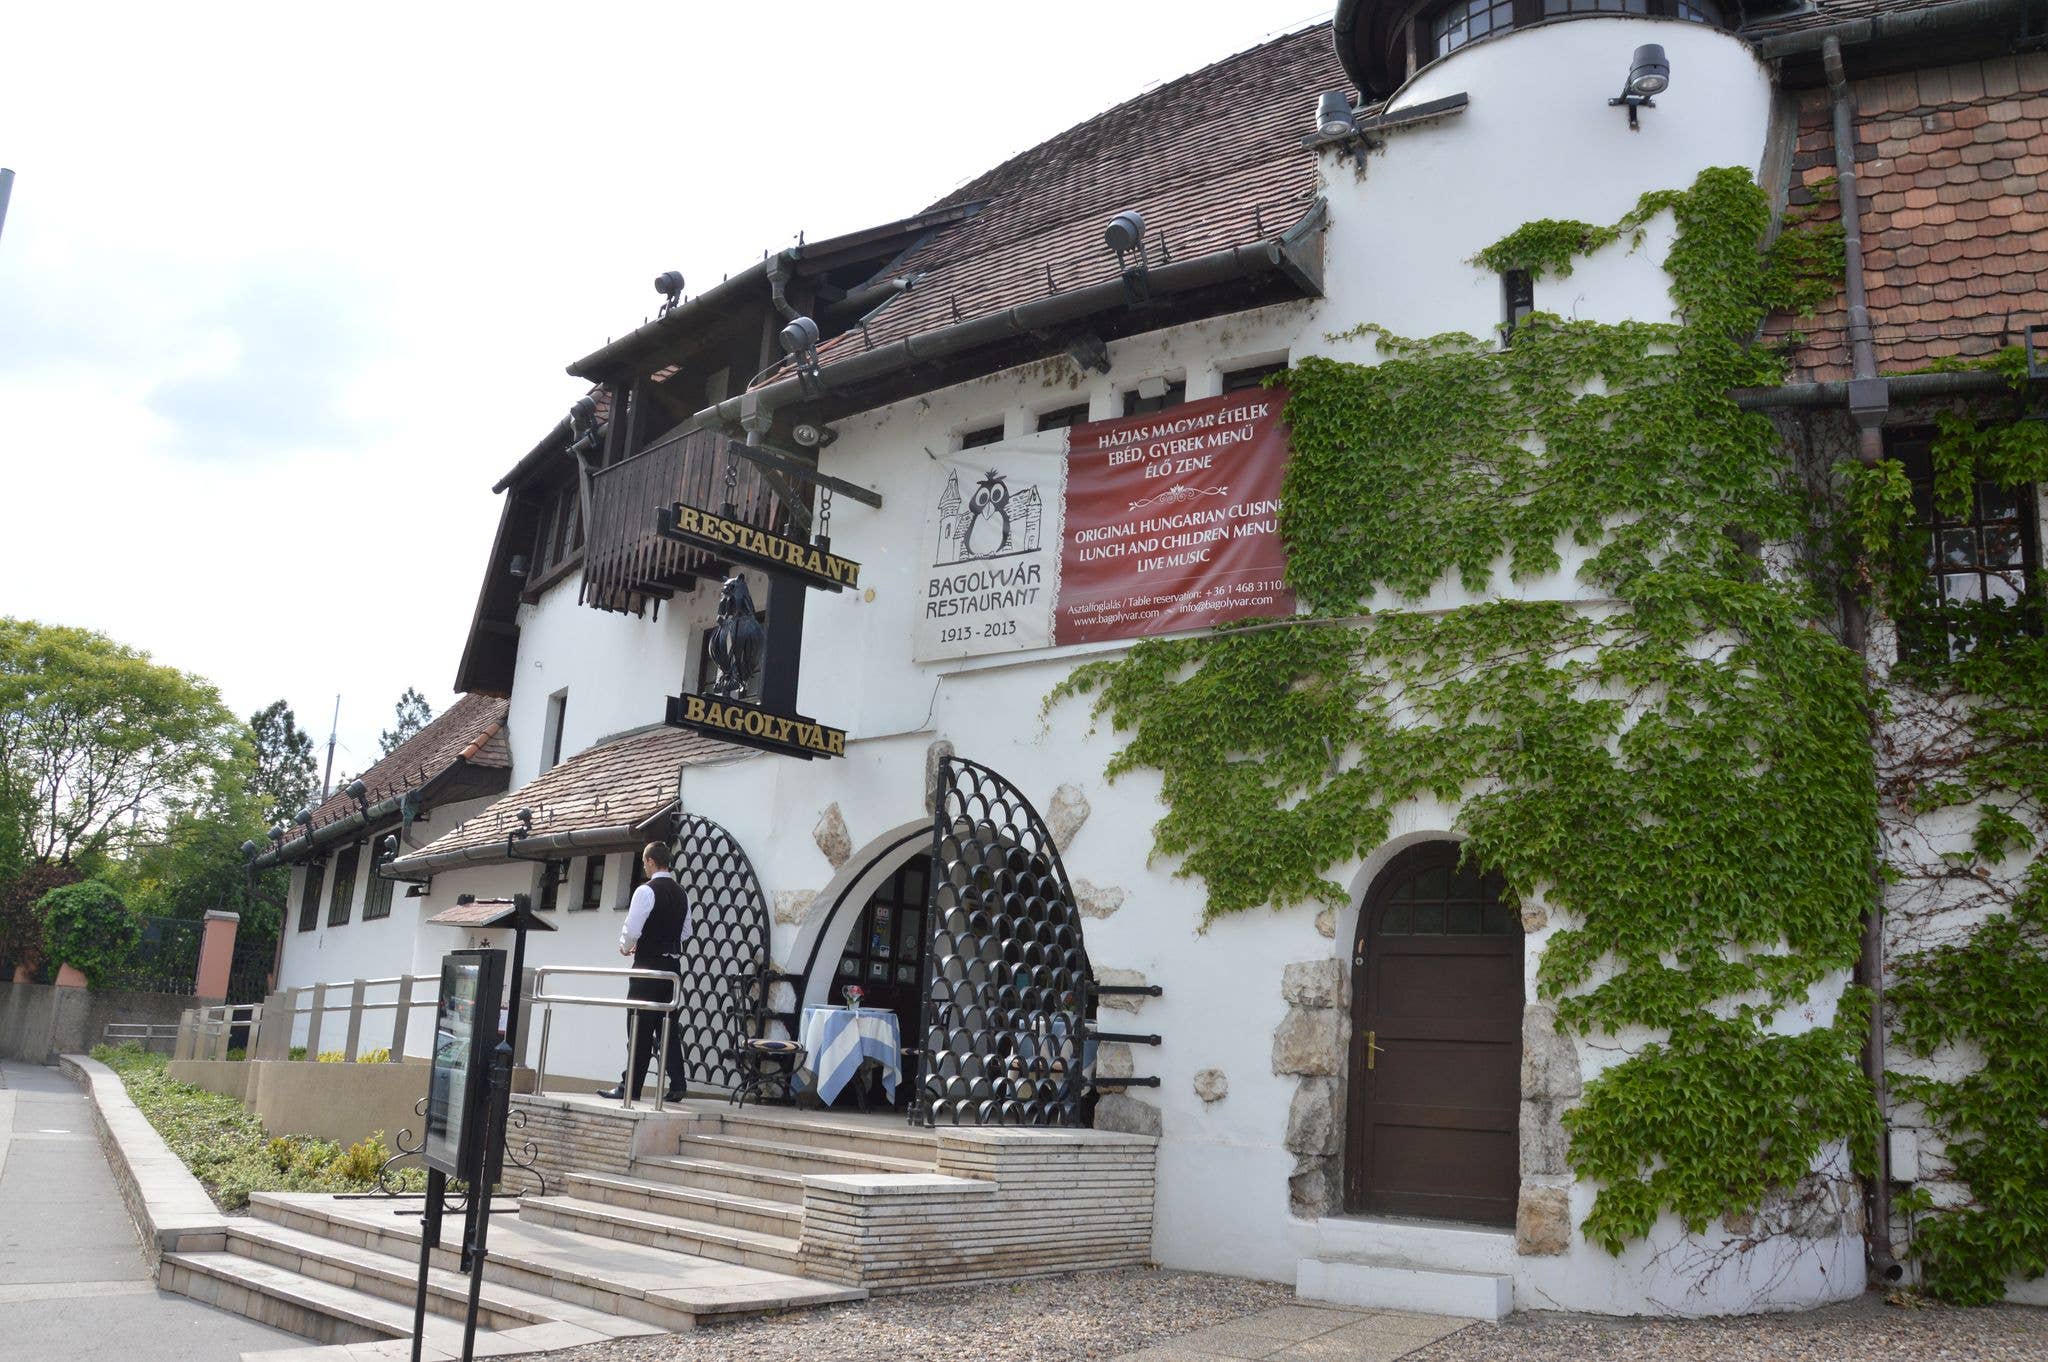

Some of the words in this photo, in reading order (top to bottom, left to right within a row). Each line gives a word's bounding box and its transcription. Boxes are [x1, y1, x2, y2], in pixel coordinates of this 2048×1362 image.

[1099, 427, 1149, 449] HÁZIAS
[1151, 415, 1215, 438] MAGYAR
[1217, 403, 1269, 425] ÉTELEK
[1108, 445, 1146, 466] EBÉD,
[1149, 436, 1205, 458] GYEREK
[1176, 454, 1213, 474] ZENE
[1075, 522, 1137, 544] ORIGINAL
[1140, 507, 1226, 533] HUNGARIAN
[1080, 543, 1125, 562] LUNCH
[1128, 538, 1159, 555] AND
[1162, 526, 1230, 550] CHILDREN
[1233, 520, 1278, 538] MENU
[677, 505, 861, 585] RESTAURANT
[1137, 556, 1165, 573] LIVE
[1166, 548, 1210, 569] MUSIC
[928, 562, 1041, 598] BAGOLYVÁR
[1067, 599, 1121, 615] Asztalfoglalás
[1128, 595, 1151, 607] Table
[1153, 590, 1202, 606] reservation:
[1235, 582, 1255, 593] 468
[1256, 579, 1282, 591] 3110
[926, 588, 1040, 619] RESTAURANT
[1073, 609, 1160, 627] www.bagolyvar.com
[1179, 596, 1273, 613] info@bagolyvar.com
[940, 627, 971, 643] 1913
[984, 621, 1017, 638] 2013
[684, 696, 846, 755] BAGOLYVAR
